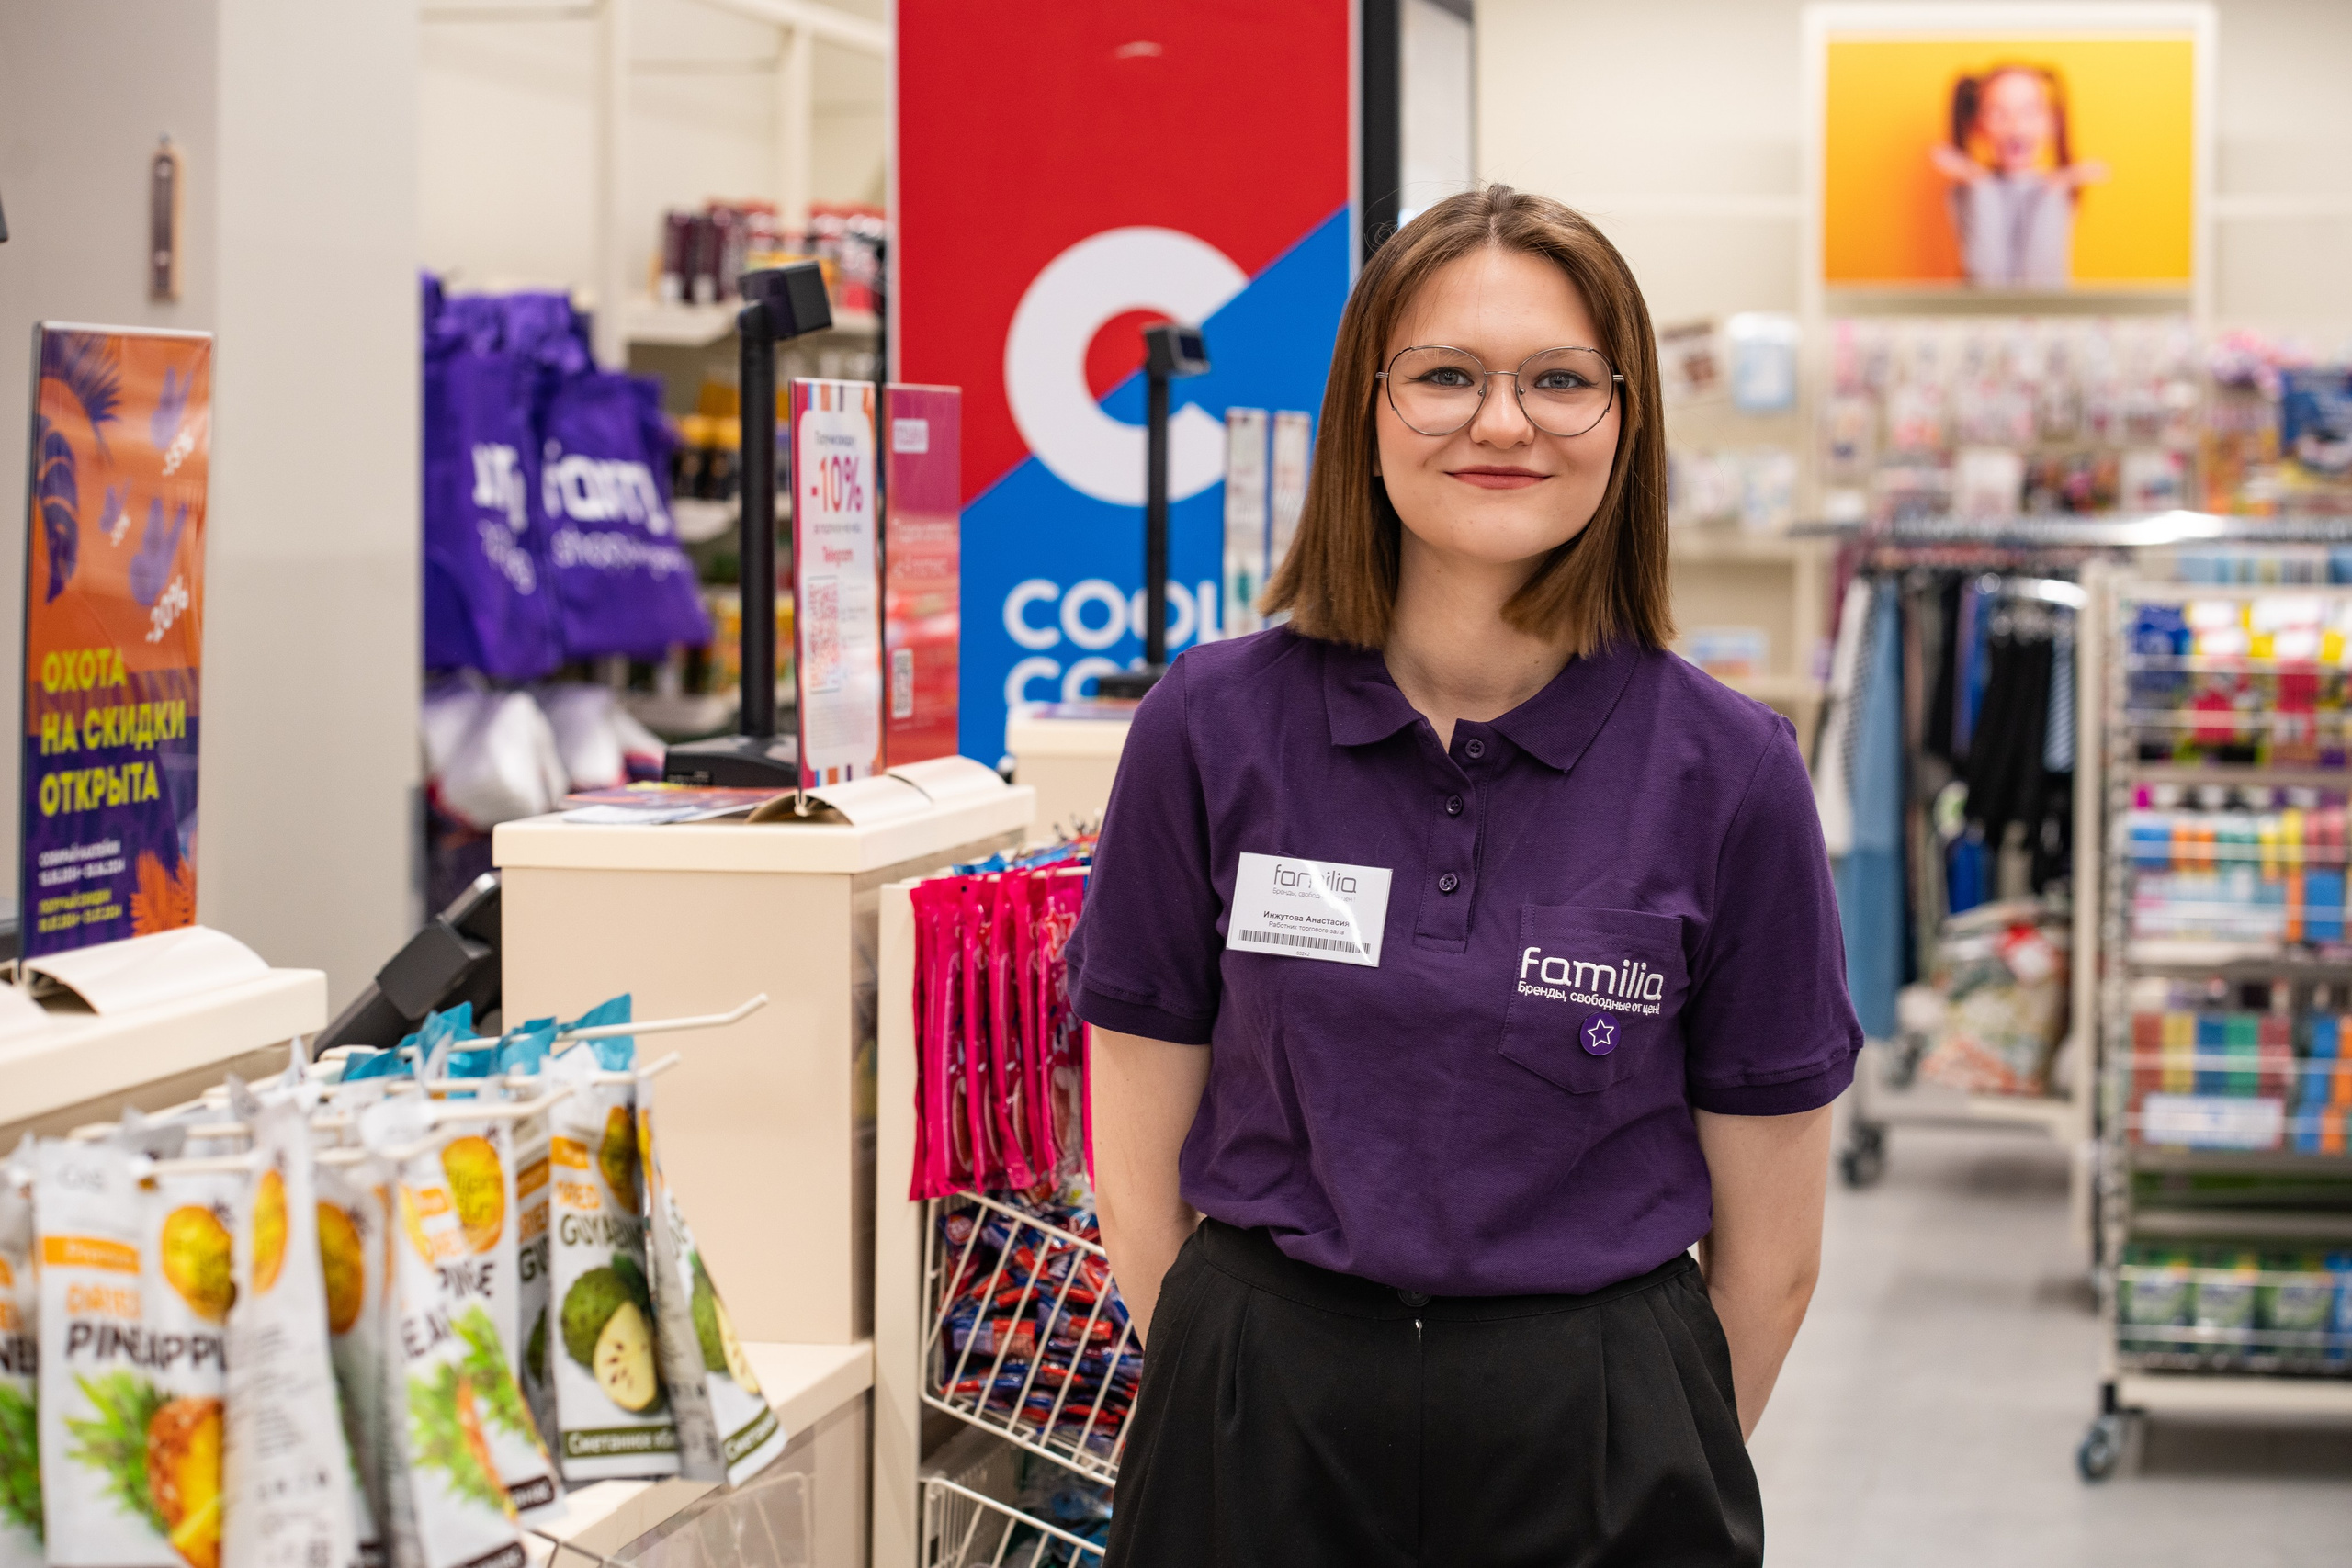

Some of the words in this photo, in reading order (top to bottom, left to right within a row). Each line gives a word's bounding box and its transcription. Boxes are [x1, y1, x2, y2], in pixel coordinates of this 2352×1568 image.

[1004, 226, 1251, 507] C
[810, 455, 864, 513] -10%
[146, 575, 189, 643] -20%
[41, 647, 127, 694] ОХОТА
[40, 712, 79, 756] НА
[83, 699, 187, 751] СКИДКИ
[39, 761, 160, 818] ОТКРЫТА
[1263, 910, 1304, 922] Инжутова
[1306, 915, 1350, 928] Анастасия
[1268, 920, 1297, 931] Работник
[1298, 925, 1329, 934] торгового
[1517, 980, 1567, 1002] Бренды,
[1569, 992, 1632, 1012] свободные
[1631, 1002, 1643, 1013] от
[1642, 1003, 1660, 1016] цен!
[1520, 946, 1664, 1001] familia
